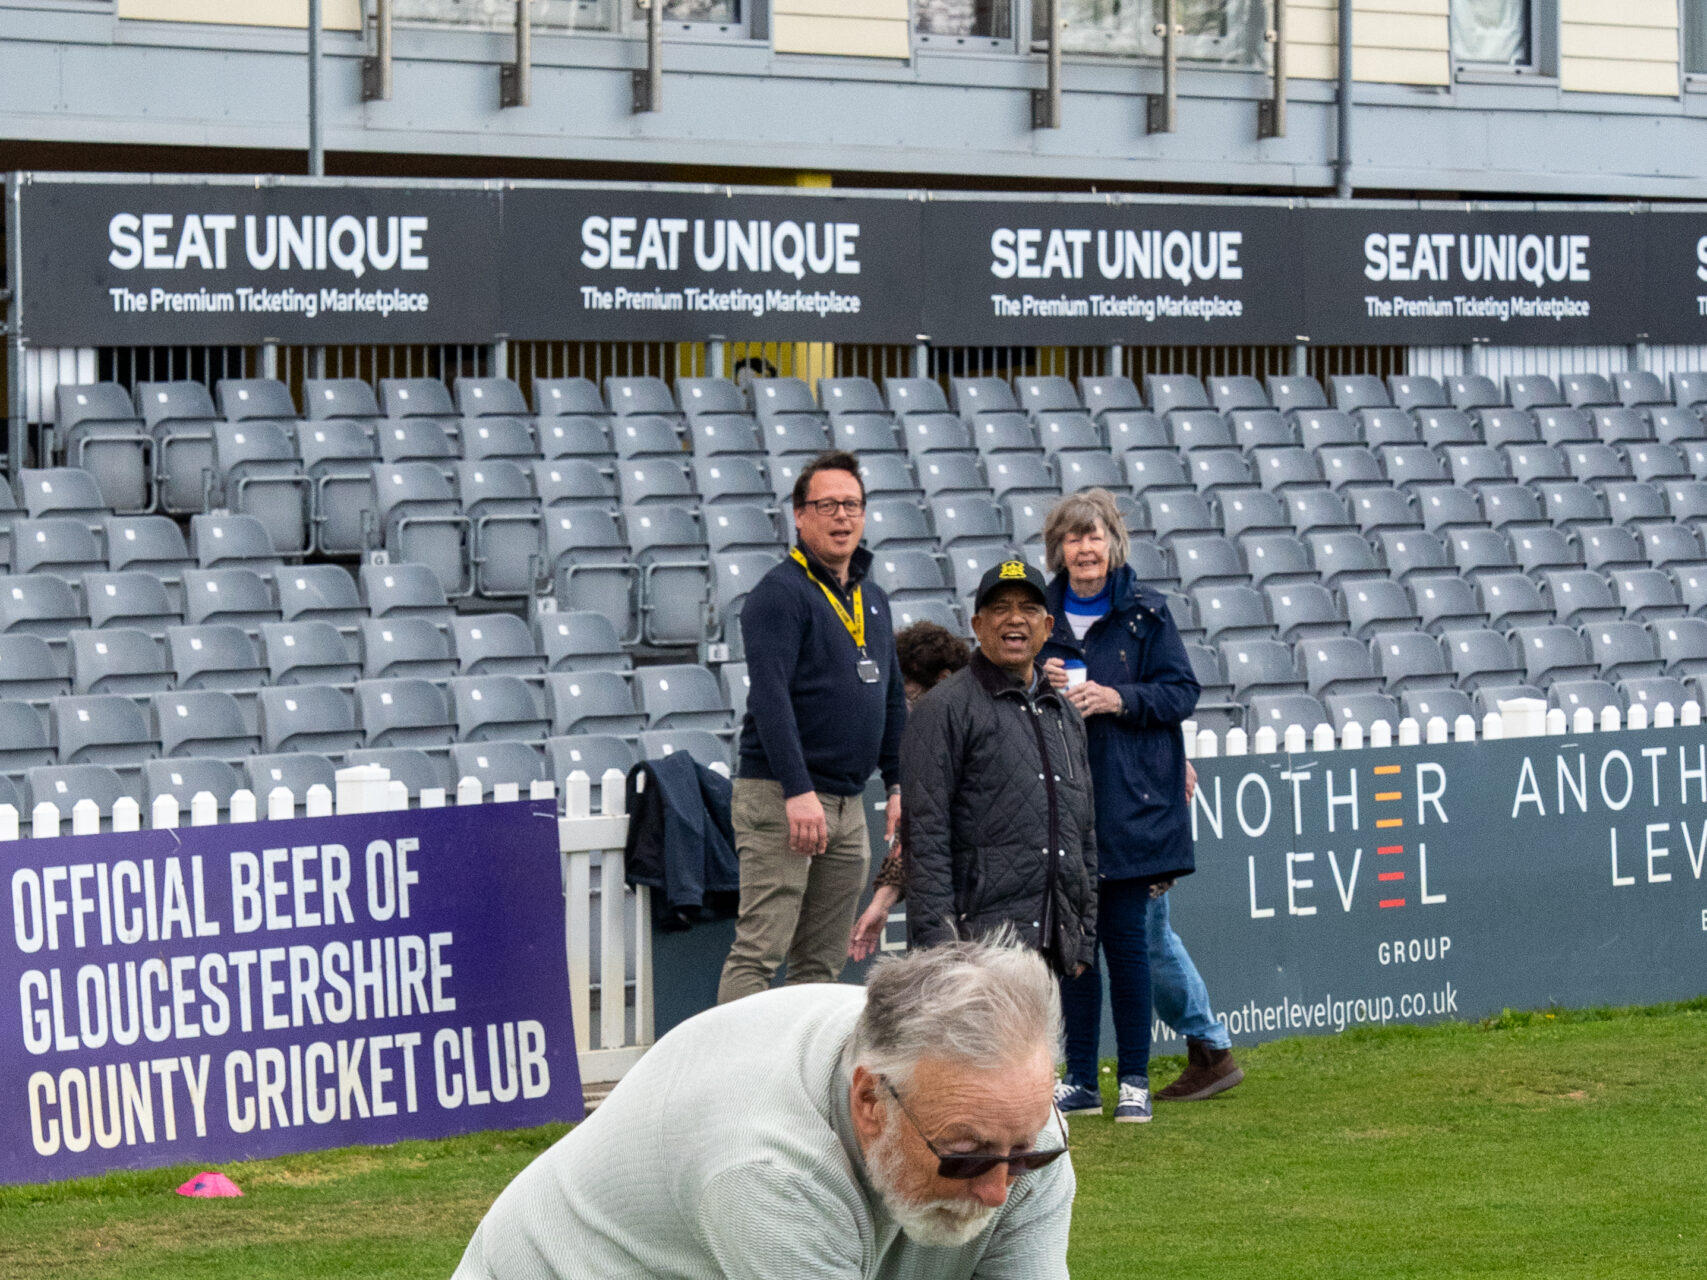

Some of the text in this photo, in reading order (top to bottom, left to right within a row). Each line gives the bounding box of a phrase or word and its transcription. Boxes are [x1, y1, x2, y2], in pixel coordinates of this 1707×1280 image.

[108, 213, 429, 278] SEAT UNIQUE
[580, 215, 861, 281] SEAT UNIQUE
[990, 228, 1243, 287] SEAT UNIQUE
[1364, 233, 1590, 288] SEAT UNIQUE
[109, 287, 429, 318] The Premium Ticketing Marketplace
[580, 286, 861, 318] The Premium Ticketing Marketplace
[990, 294, 1243, 322] The Premium Ticketing Marketplace
[1364, 295, 1590, 322] The Premium Ticketing Marketplace
[1186, 761, 1449, 842] NOTHER
[1511, 744, 1707, 819] ANOTH
[1247, 841, 1448, 920] LEVEL
[1610, 818, 1707, 887] LEV
[11, 837, 420, 954] OFFICIAL BEER OF
[1378, 936, 1453, 967] GROUP
[19, 931, 456, 1055] GLOUCESTERSHIRE
[27, 1019, 551, 1157] COUNTY CRICKET CLUB
